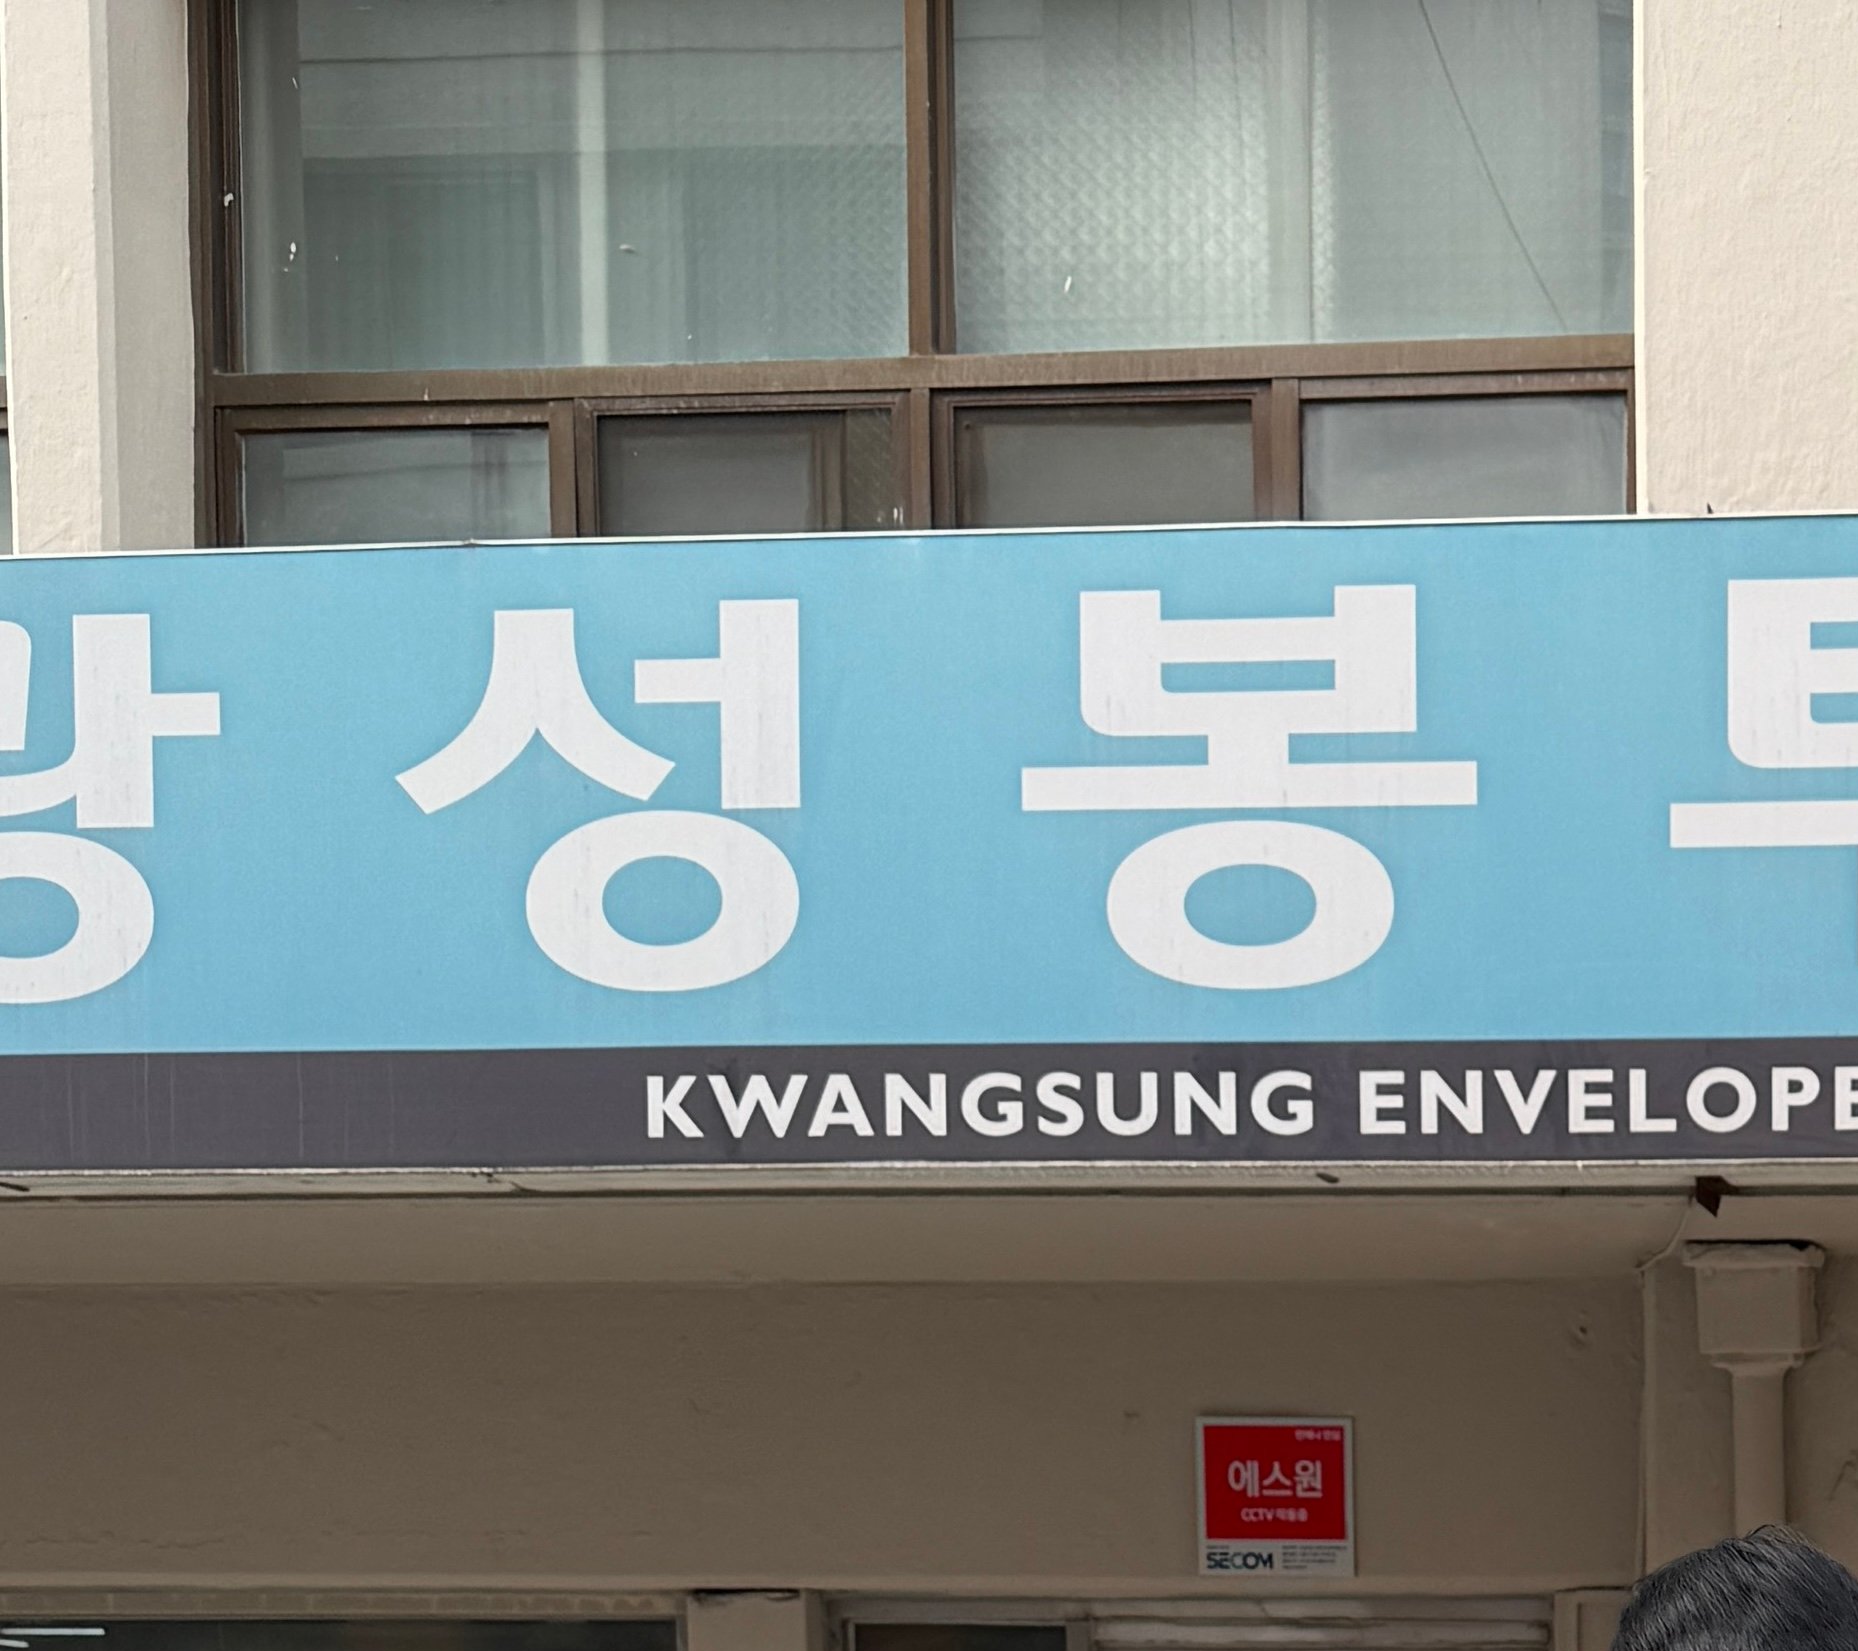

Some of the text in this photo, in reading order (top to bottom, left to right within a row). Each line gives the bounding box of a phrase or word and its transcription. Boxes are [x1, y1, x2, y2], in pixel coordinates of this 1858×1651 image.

[647, 1070, 1313, 1138] KWANGSUNG
[1228, 1460, 1322, 1498] 에스원
[1206, 1552, 1274, 1570] SECOM
